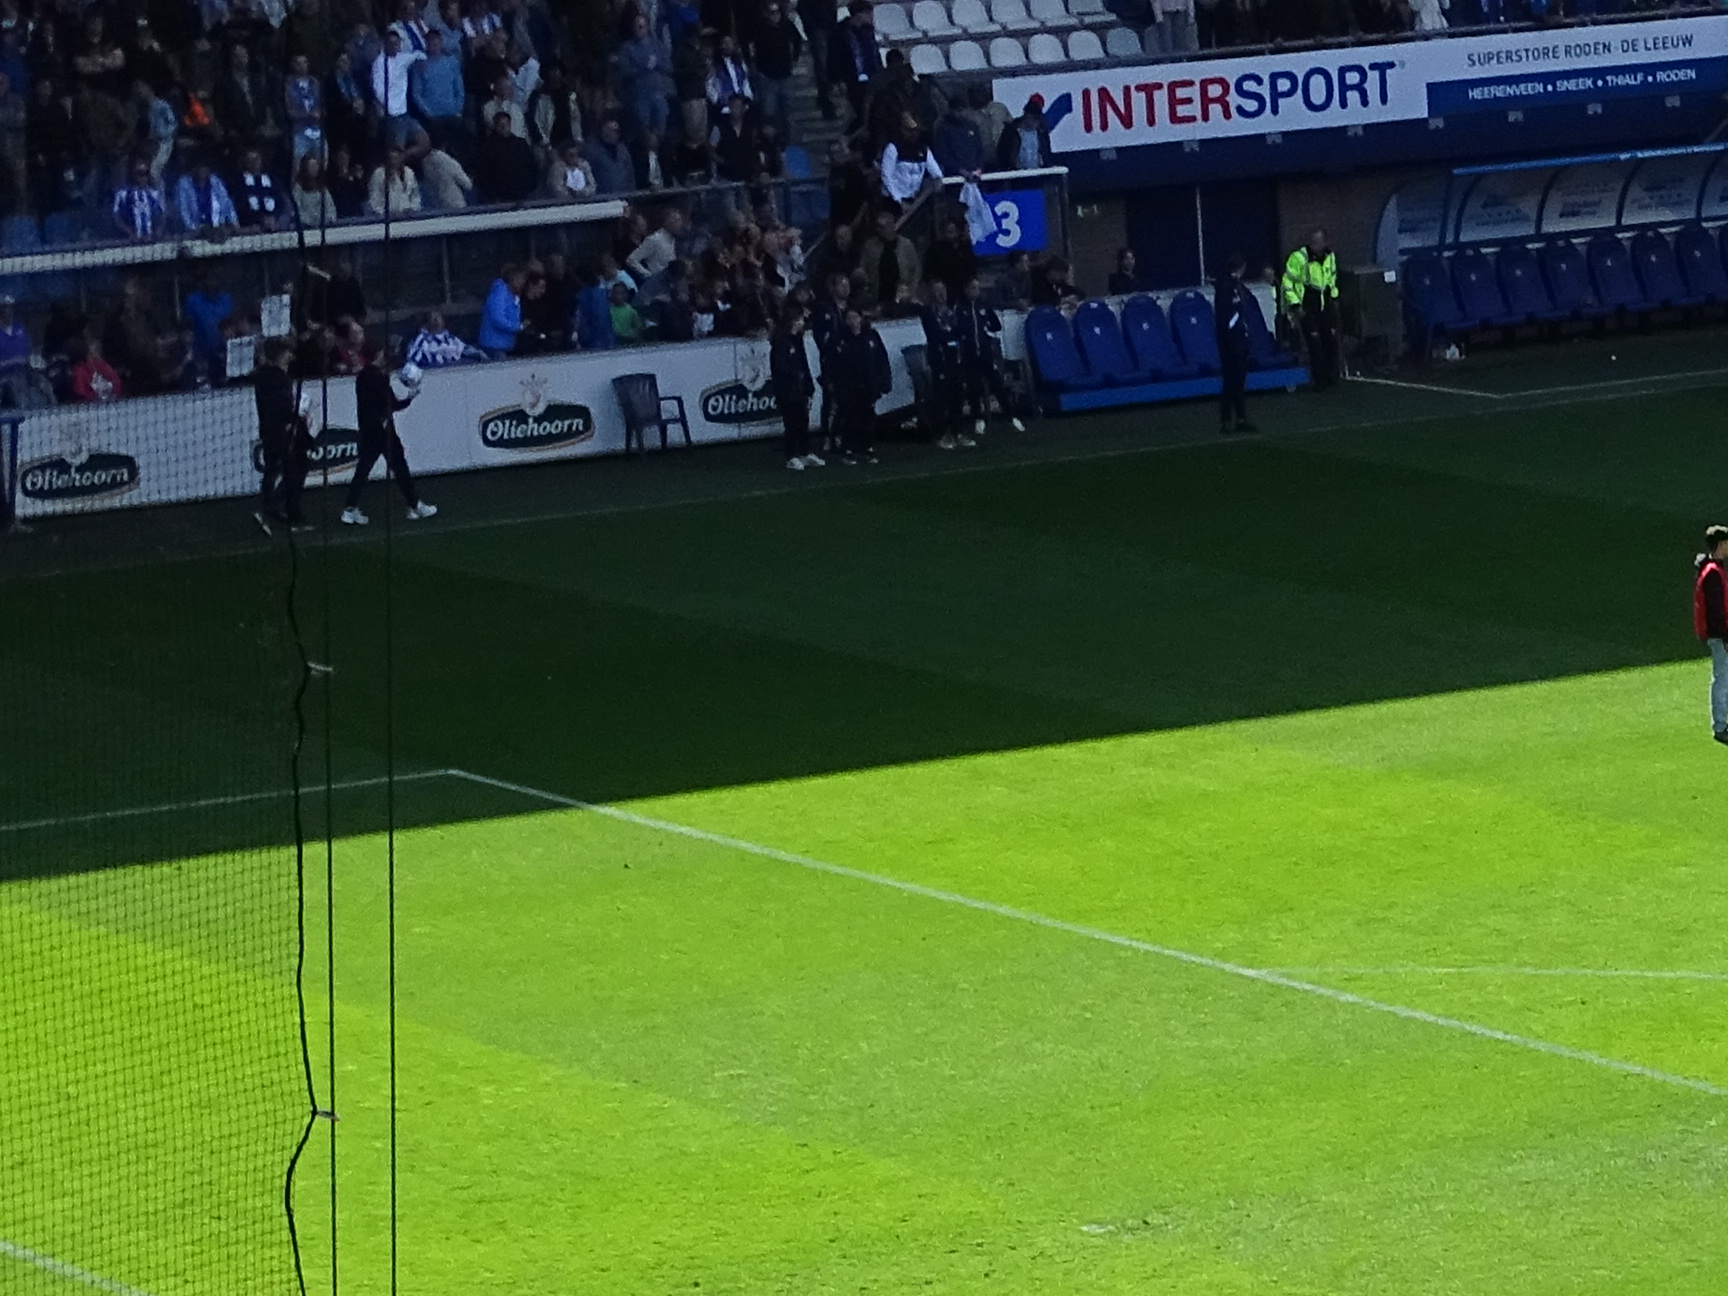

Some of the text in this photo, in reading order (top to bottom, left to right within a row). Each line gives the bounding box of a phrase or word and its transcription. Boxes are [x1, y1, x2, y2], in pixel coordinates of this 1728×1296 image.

[1467, 32, 1694, 68] SUPERSTORE RODEN DE LEEUW
[1082, 61, 1396, 133] INTERSPORT
[1467, 63, 1697, 100] HEERENVEEN SNEEK THIALF RODEN
[993, 200, 1021, 247] 3
[486, 417, 583, 441] Oliehoorn
